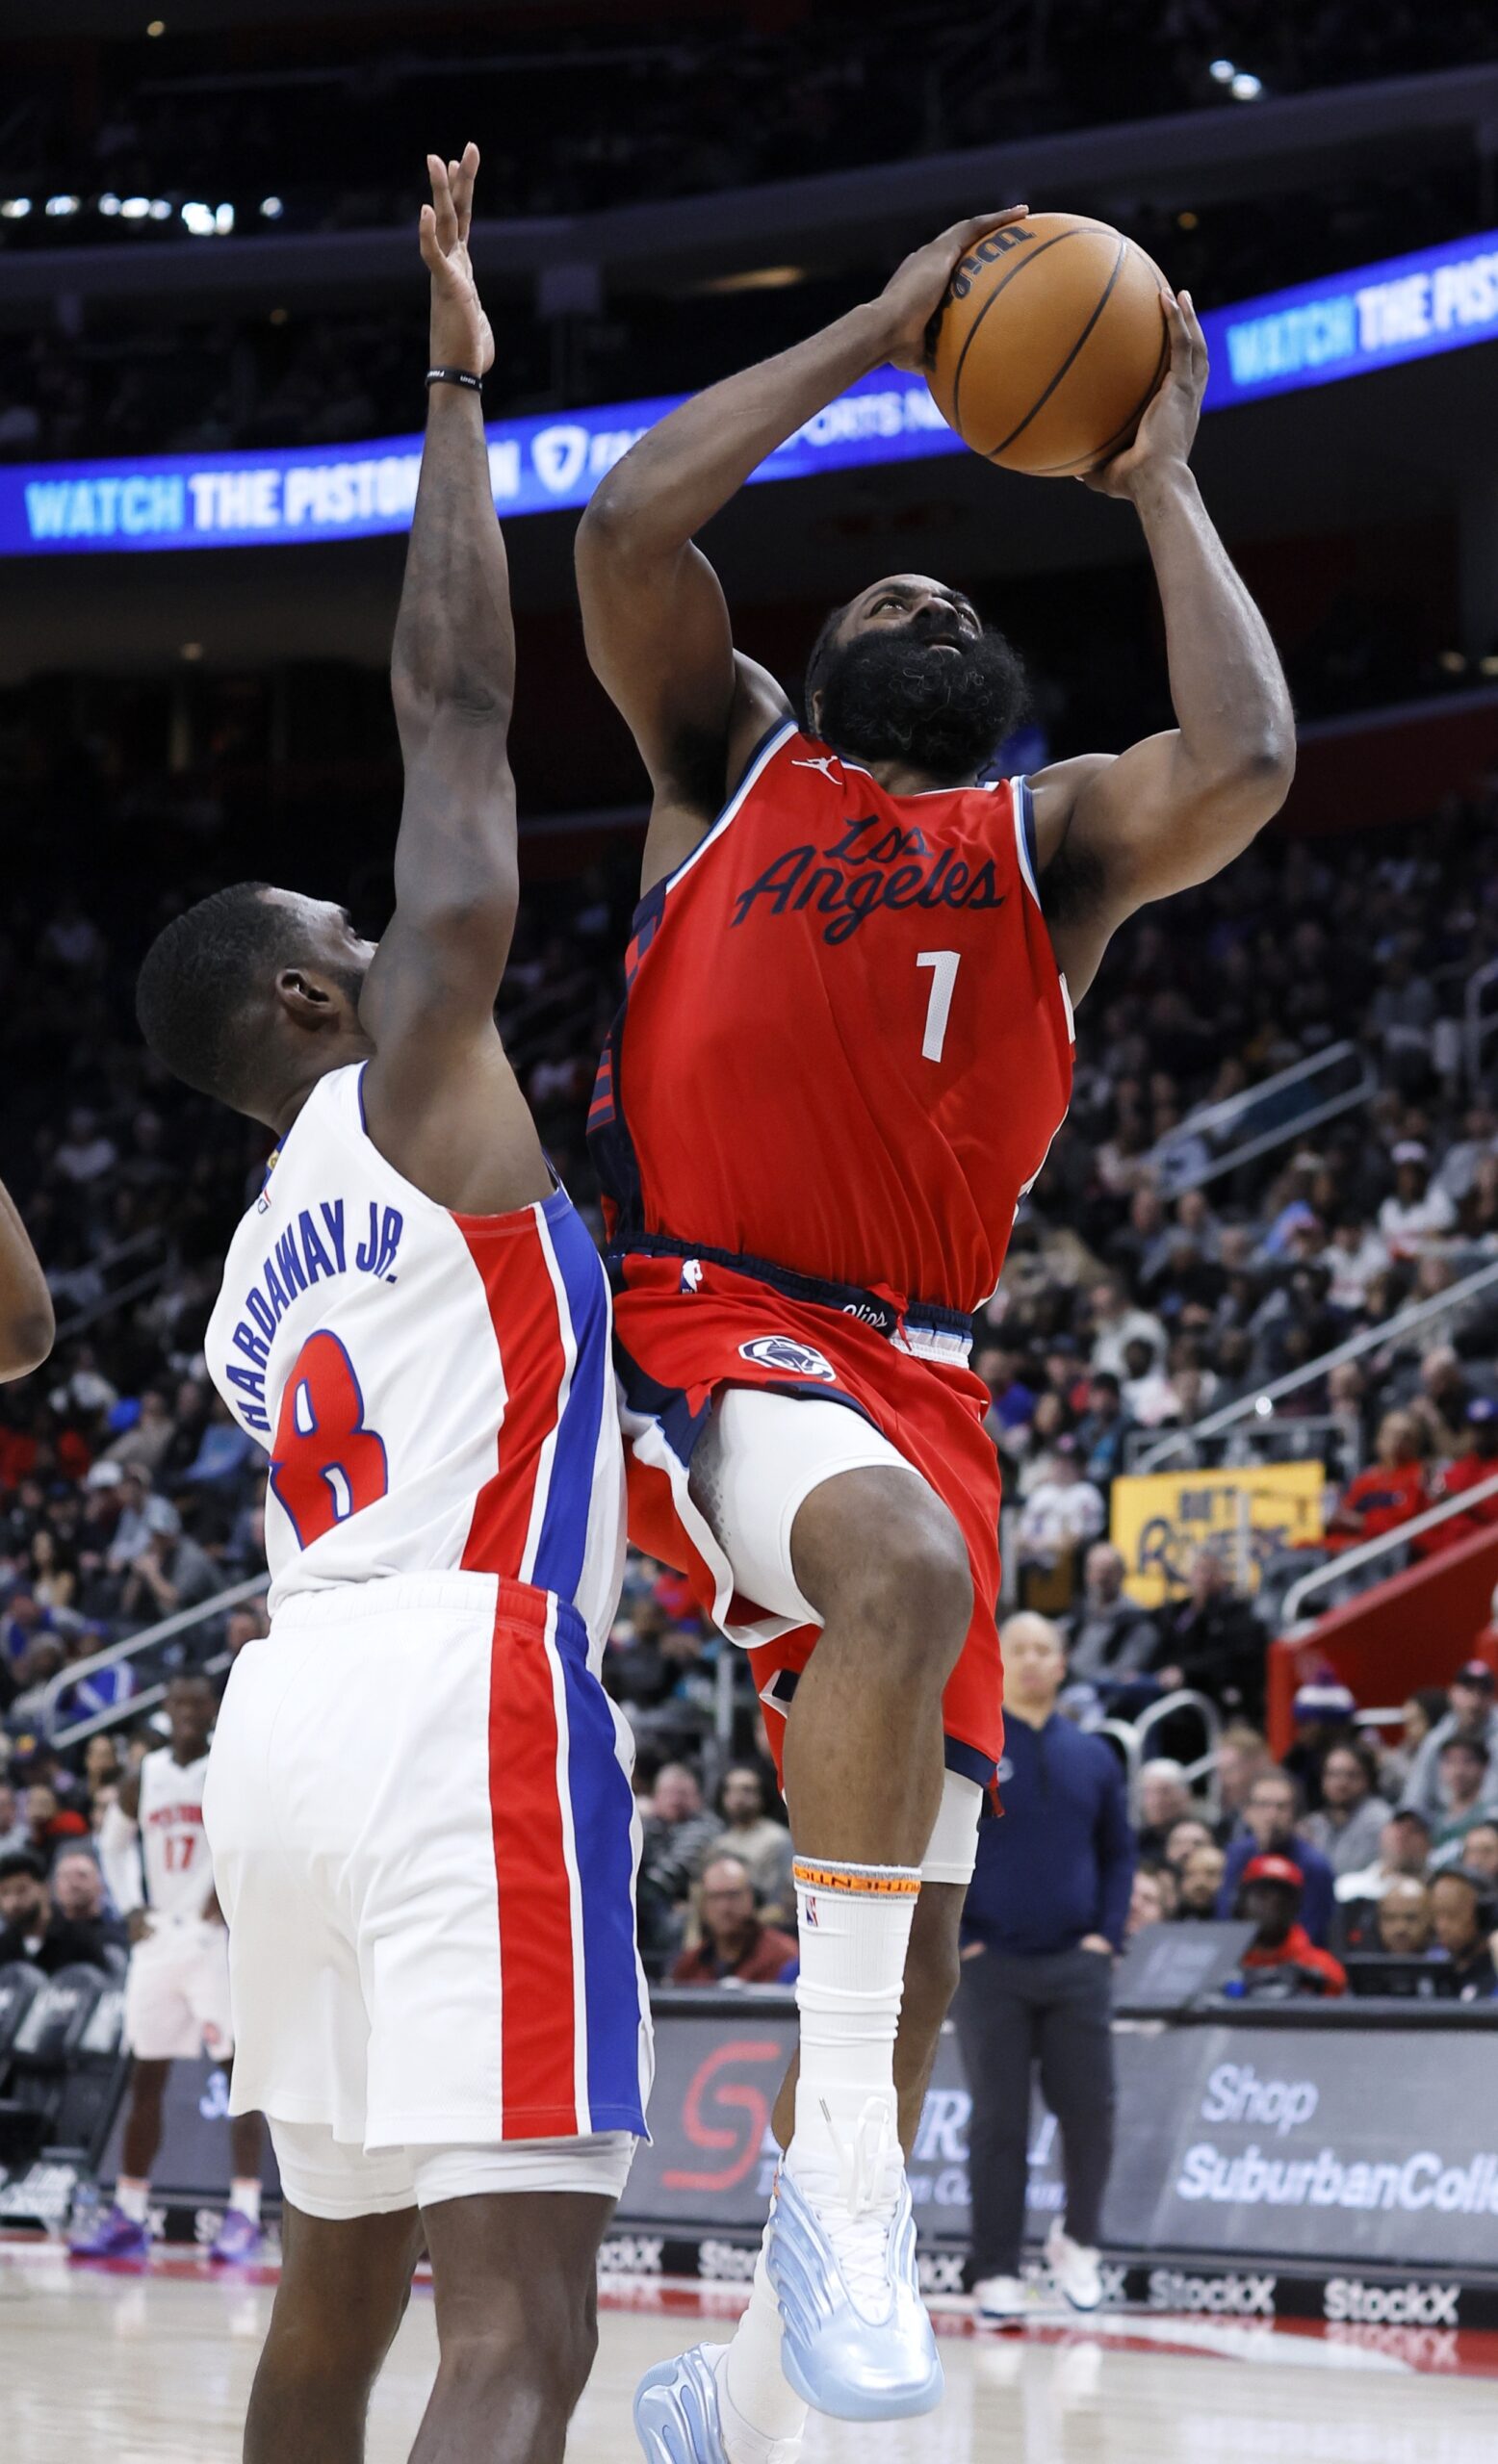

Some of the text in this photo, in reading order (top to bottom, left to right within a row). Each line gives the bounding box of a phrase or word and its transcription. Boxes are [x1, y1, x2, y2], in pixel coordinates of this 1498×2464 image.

[1227, 294, 1355, 385] WATCH
[1356, 271, 1431, 352] THE
[25, 475, 184, 541] WATCH
[189, 469, 281, 530] THE
[823, 814, 934, 865] Los
[730, 845, 1005, 945] Angeles
[916, 950, 961, 1063] 1
[225, 1198, 403, 1432] HARDAWAY JR.
[269, 1328, 389, 1553] 8
[165, 1835, 195, 1872] 17
[1201, 2064, 1319, 2137] Shop
[1149, 2270, 1277, 2314] StockX
[1323, 2277, 1461, 2326] StockX
